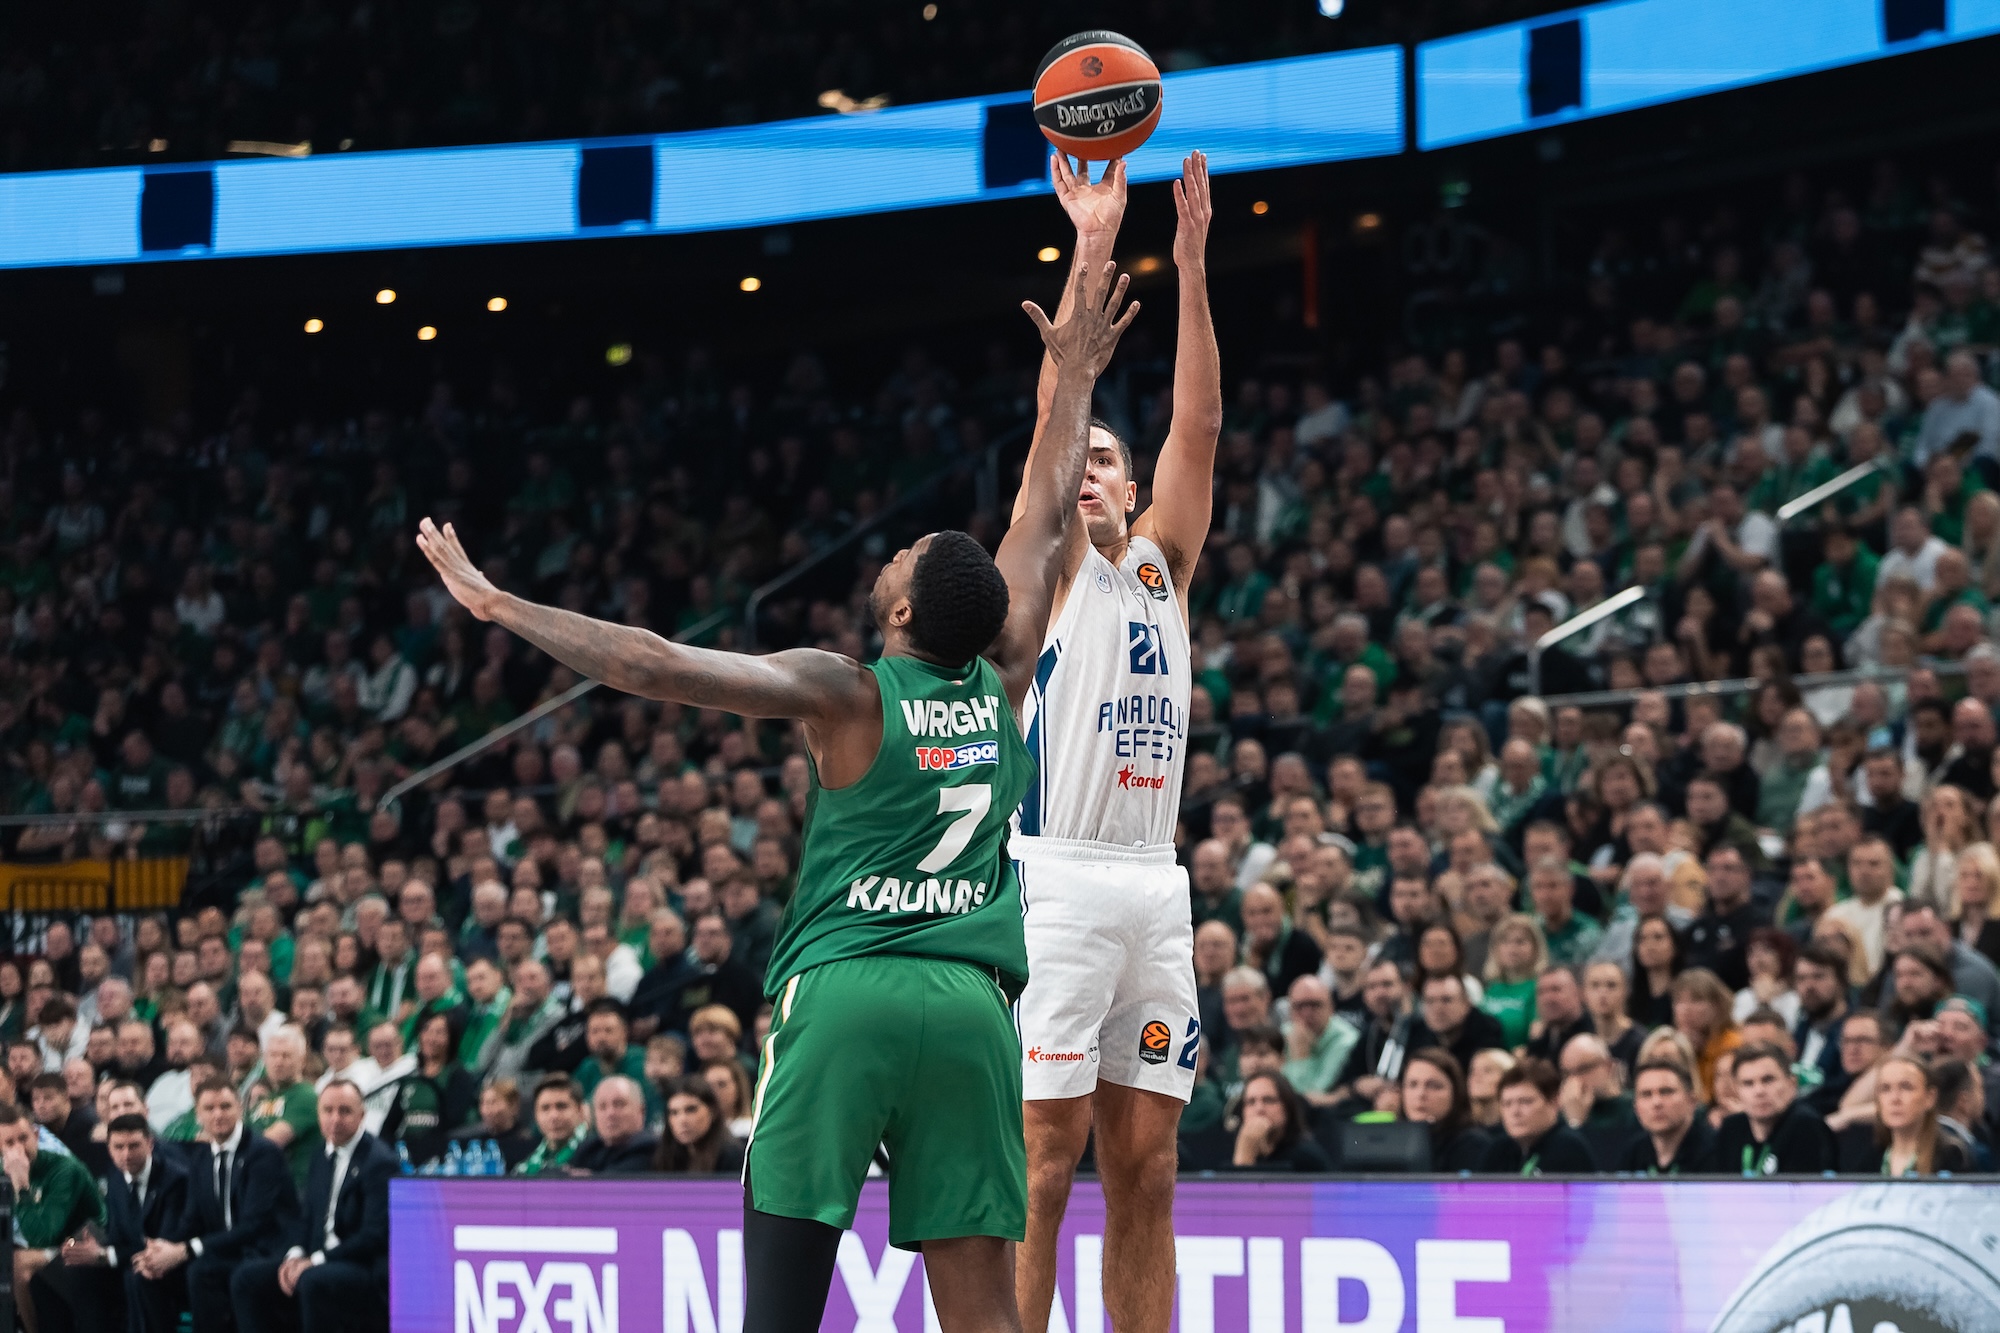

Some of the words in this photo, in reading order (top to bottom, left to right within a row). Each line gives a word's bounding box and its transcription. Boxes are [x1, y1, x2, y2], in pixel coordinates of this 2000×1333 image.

[1056, 87, 1146, 128] SPALDING
[1128, 621, 1169, 675] 21
[916, 783, 992, 874] 7
[846, 875, 986, 914] KAUNAS
[1039, 1051, 1084, 1062] corendon
